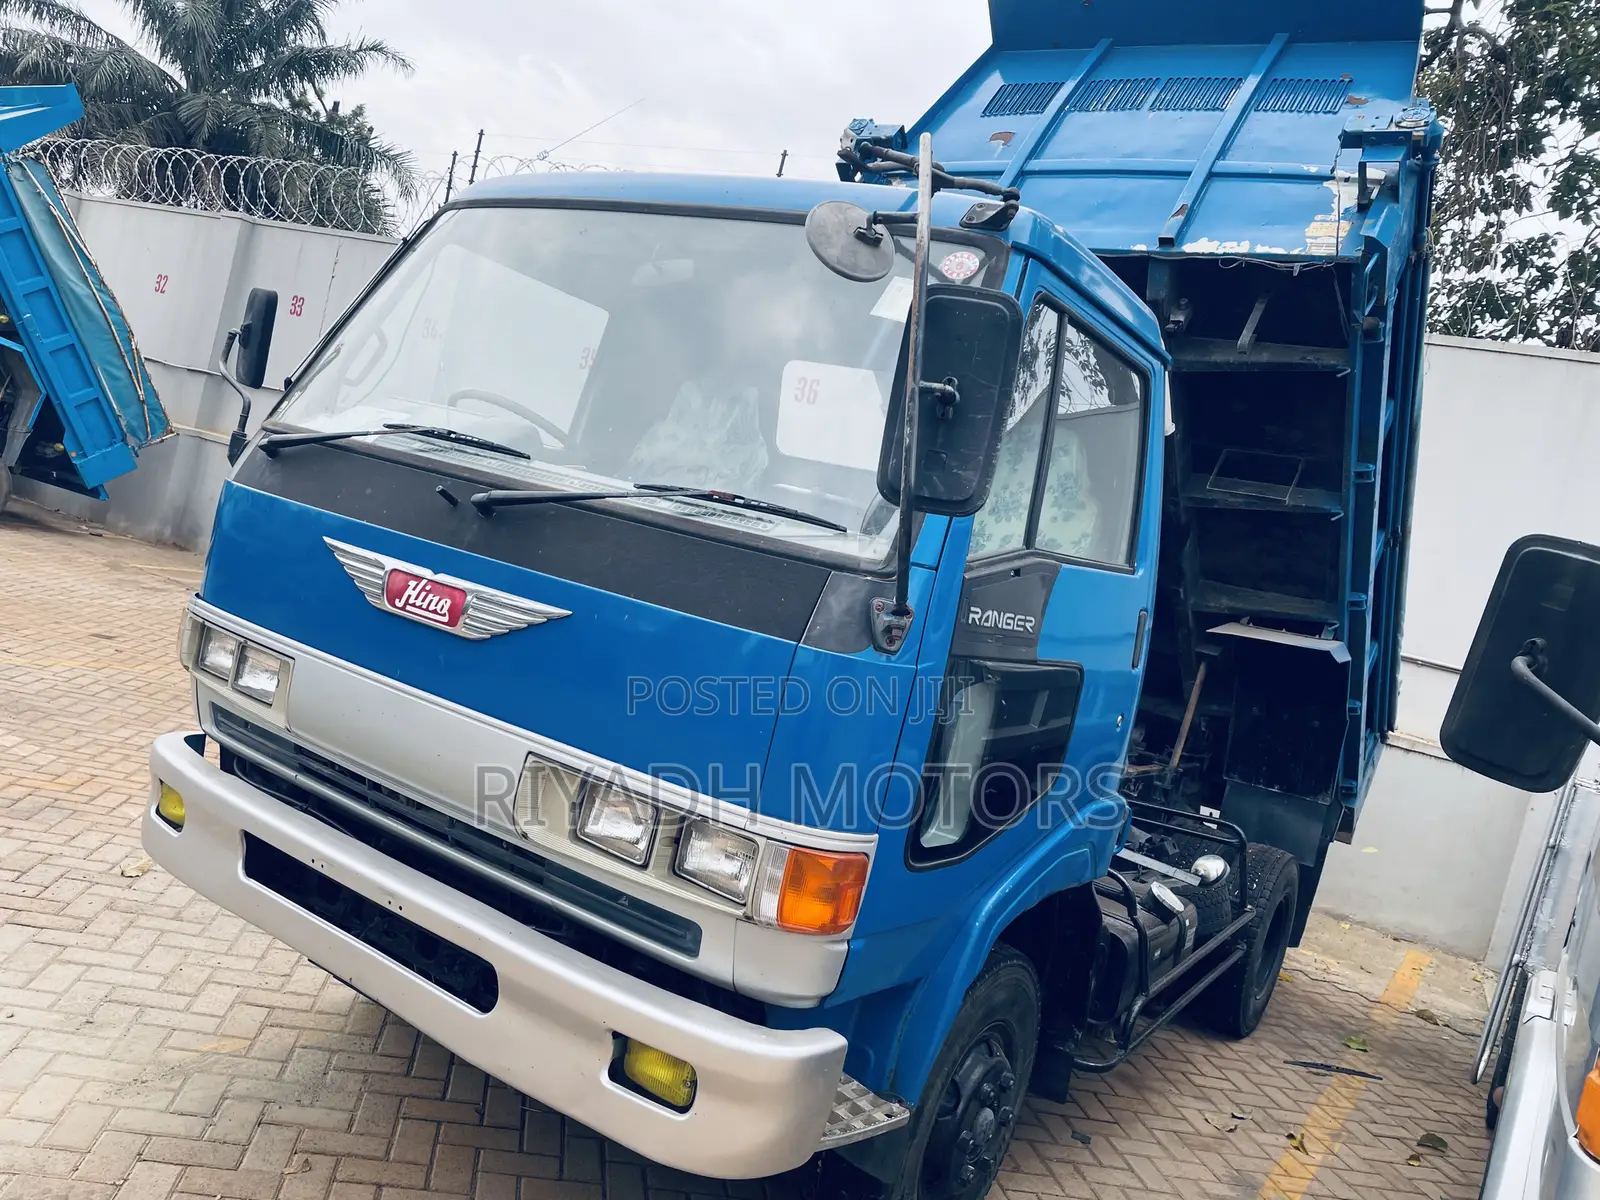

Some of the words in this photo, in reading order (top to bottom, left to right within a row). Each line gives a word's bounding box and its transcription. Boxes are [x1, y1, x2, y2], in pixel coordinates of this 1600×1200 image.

[154, 273, 169, 294] 32
[289, 295, 305, 317] 33
[794, 377, 820, 405] 36
[394, 579, 452, 622] Hino
[968, 606, 1036, 633] RANGER
